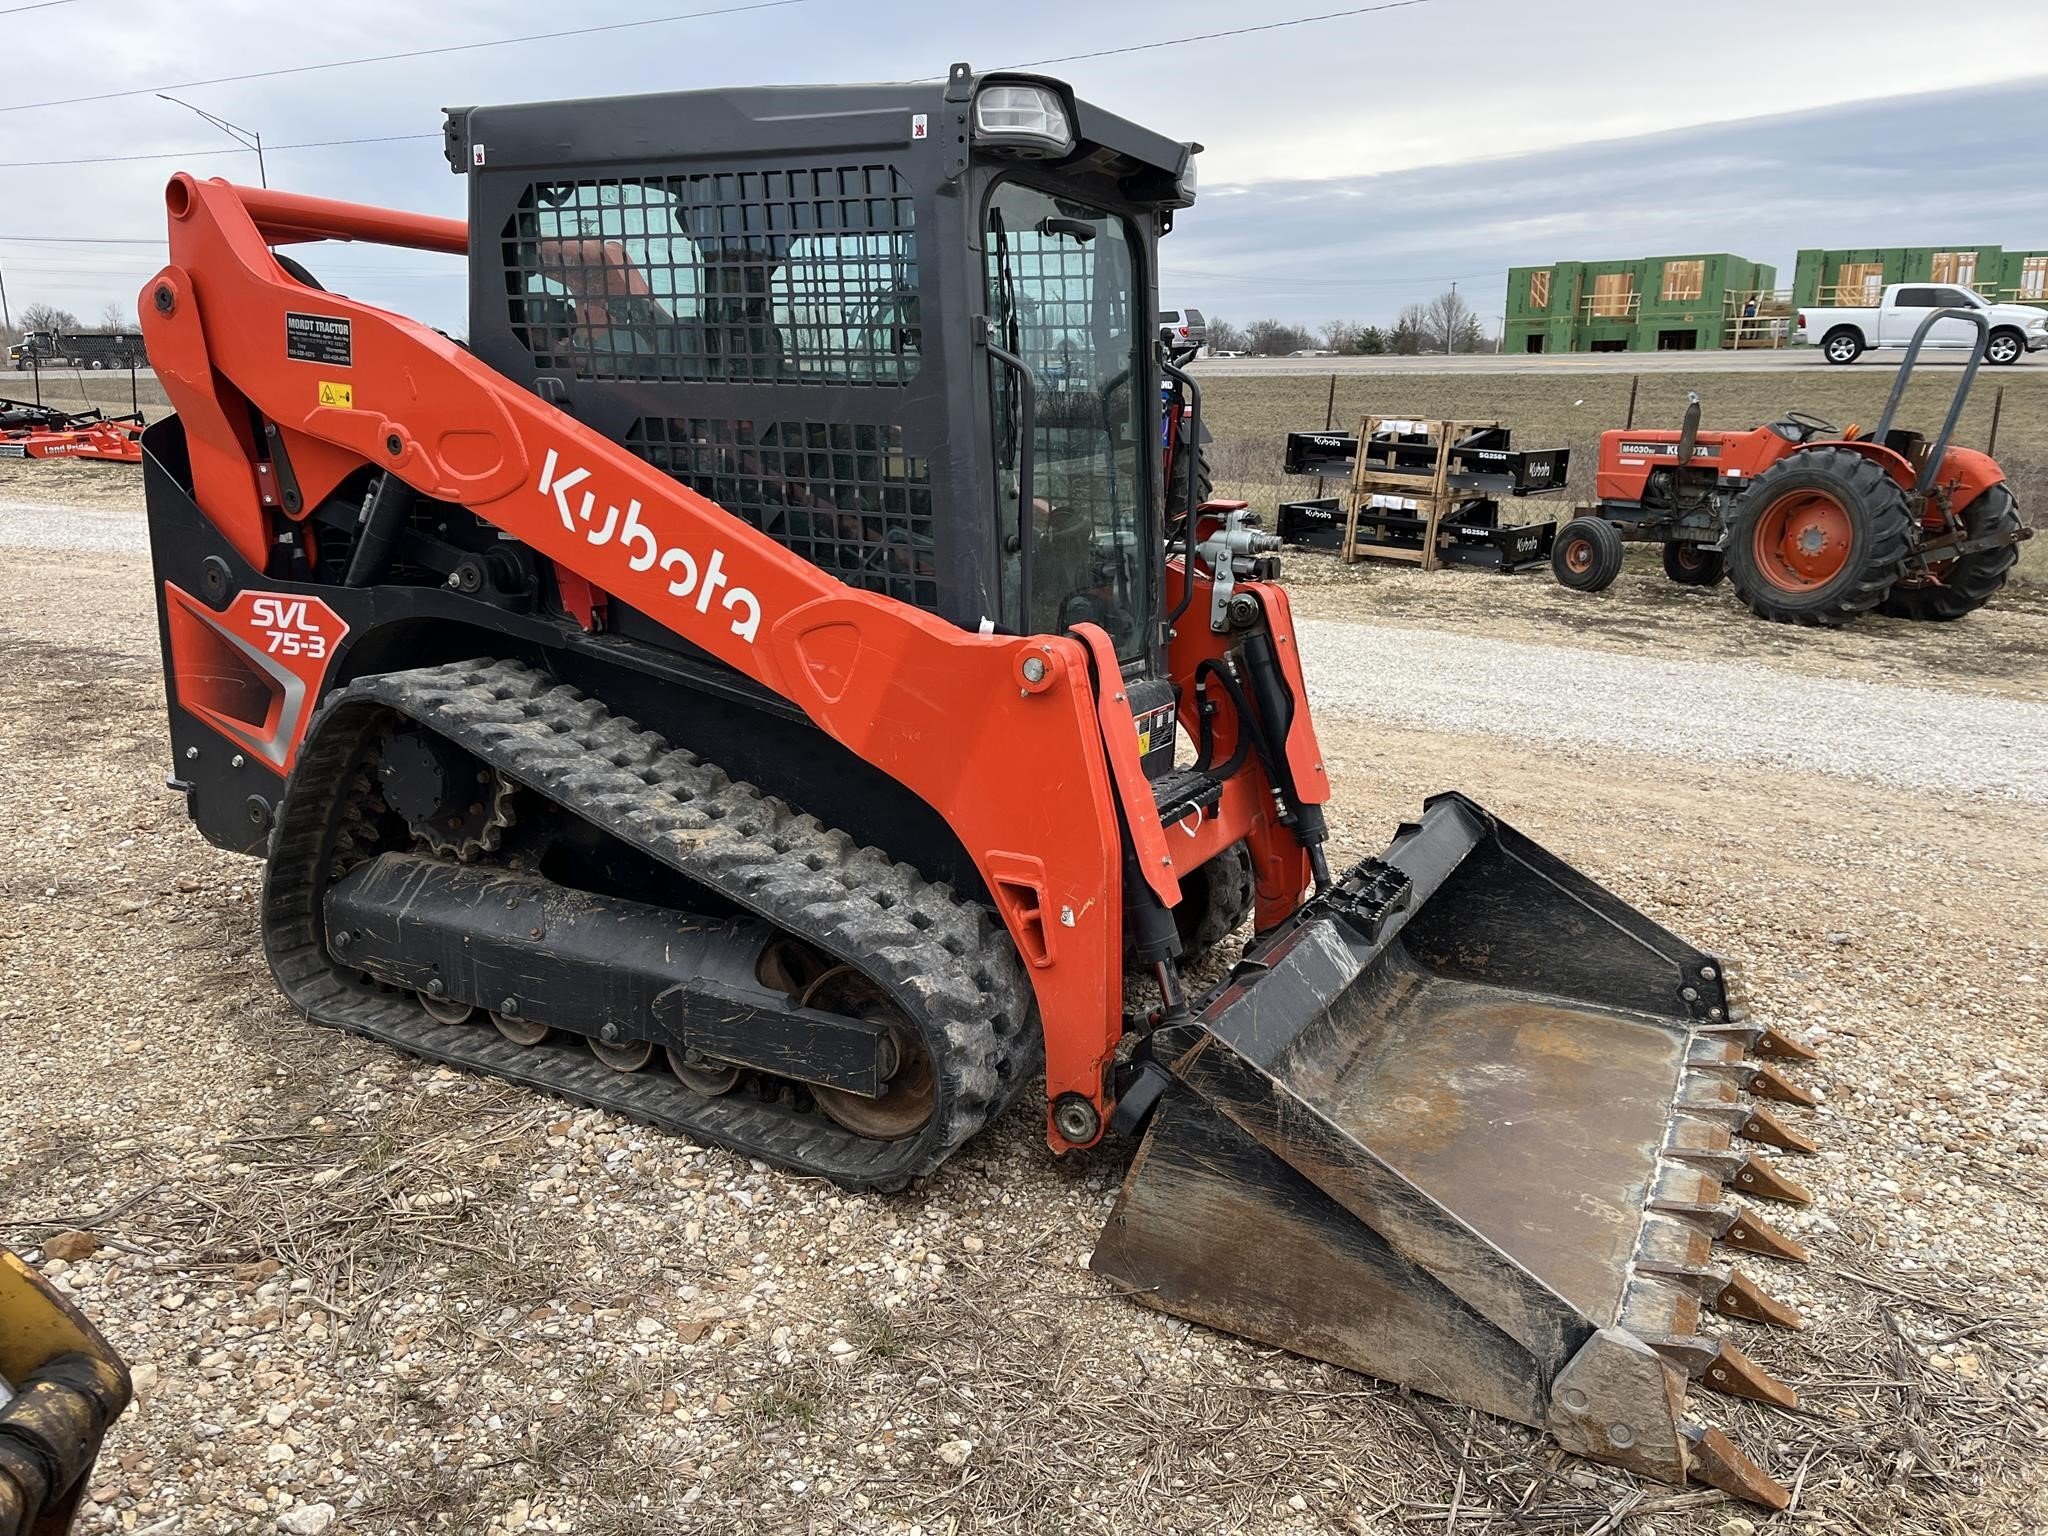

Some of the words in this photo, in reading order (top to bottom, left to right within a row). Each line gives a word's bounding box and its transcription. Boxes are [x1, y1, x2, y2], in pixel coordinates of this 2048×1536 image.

[288, 318, 314, 331] MORDT
[315, 321, 349, 335] TRACTOR
[44, 444, 65, 454] Land
[1314, 437, 1341, 447] Kubota
[1529, 462, 1550, 477] Kubota
[1305, 509, 1332, 519] Kubota
[538, 448, 762, 644] Kubota
[1517, 536, 1538, 552] Kubota
[251, 599, 320, 632] SVL
[266, 630, 326, 659] 75-3
